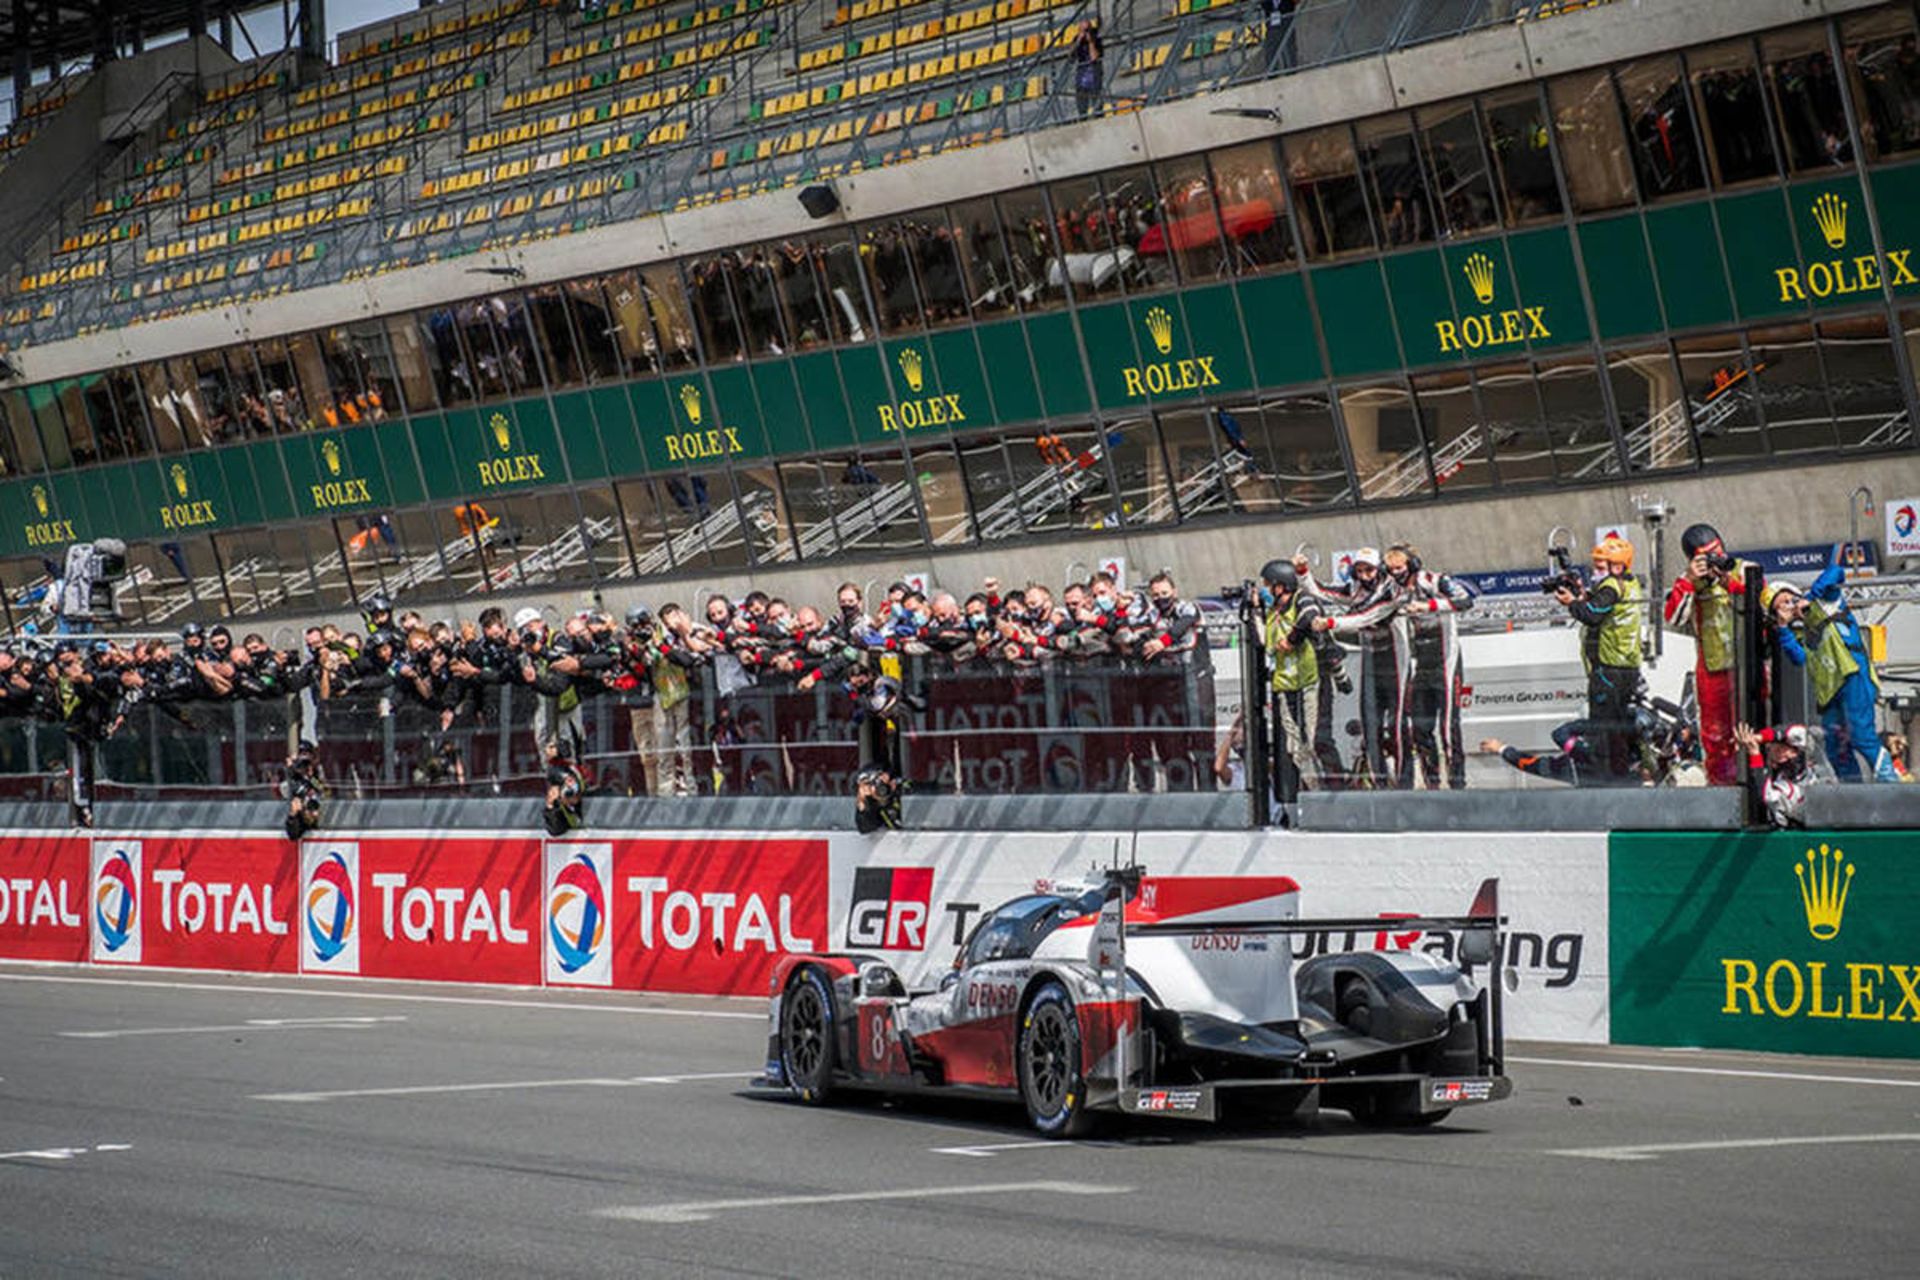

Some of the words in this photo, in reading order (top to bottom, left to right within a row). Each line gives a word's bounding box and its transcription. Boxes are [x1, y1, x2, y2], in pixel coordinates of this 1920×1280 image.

[1774, 249, 1919, 303] ROLEX
[1435, 306, 1551, 352] ROLEX
[1123, 355, 1220, 397] ROLEX
[878, 394, 966, 432] ROLEX
[665, 426, 743, 462] ROLEX
[311, 478, 371, 508] ROLEX
[479, 455, 545, 487] ROLEX
[25, 519, 76, 546] ROLEX
[161, 501, 217, 529] ROLEX
[152, 869, 288, 935] TOTAL
[372, 873, 529, 943] TOTAL
[628, 877, 815, 954] TOTAL
[849, 900, 929, 950] GR
[945, 903, 980, 946] T
[1374, 912, 1583, 987] Raing
[968, 981, 1019, 1009] DENSO
[1721, 958, 1920, 1023] ROLEX
[871, 1014, 885, 1060] 8
